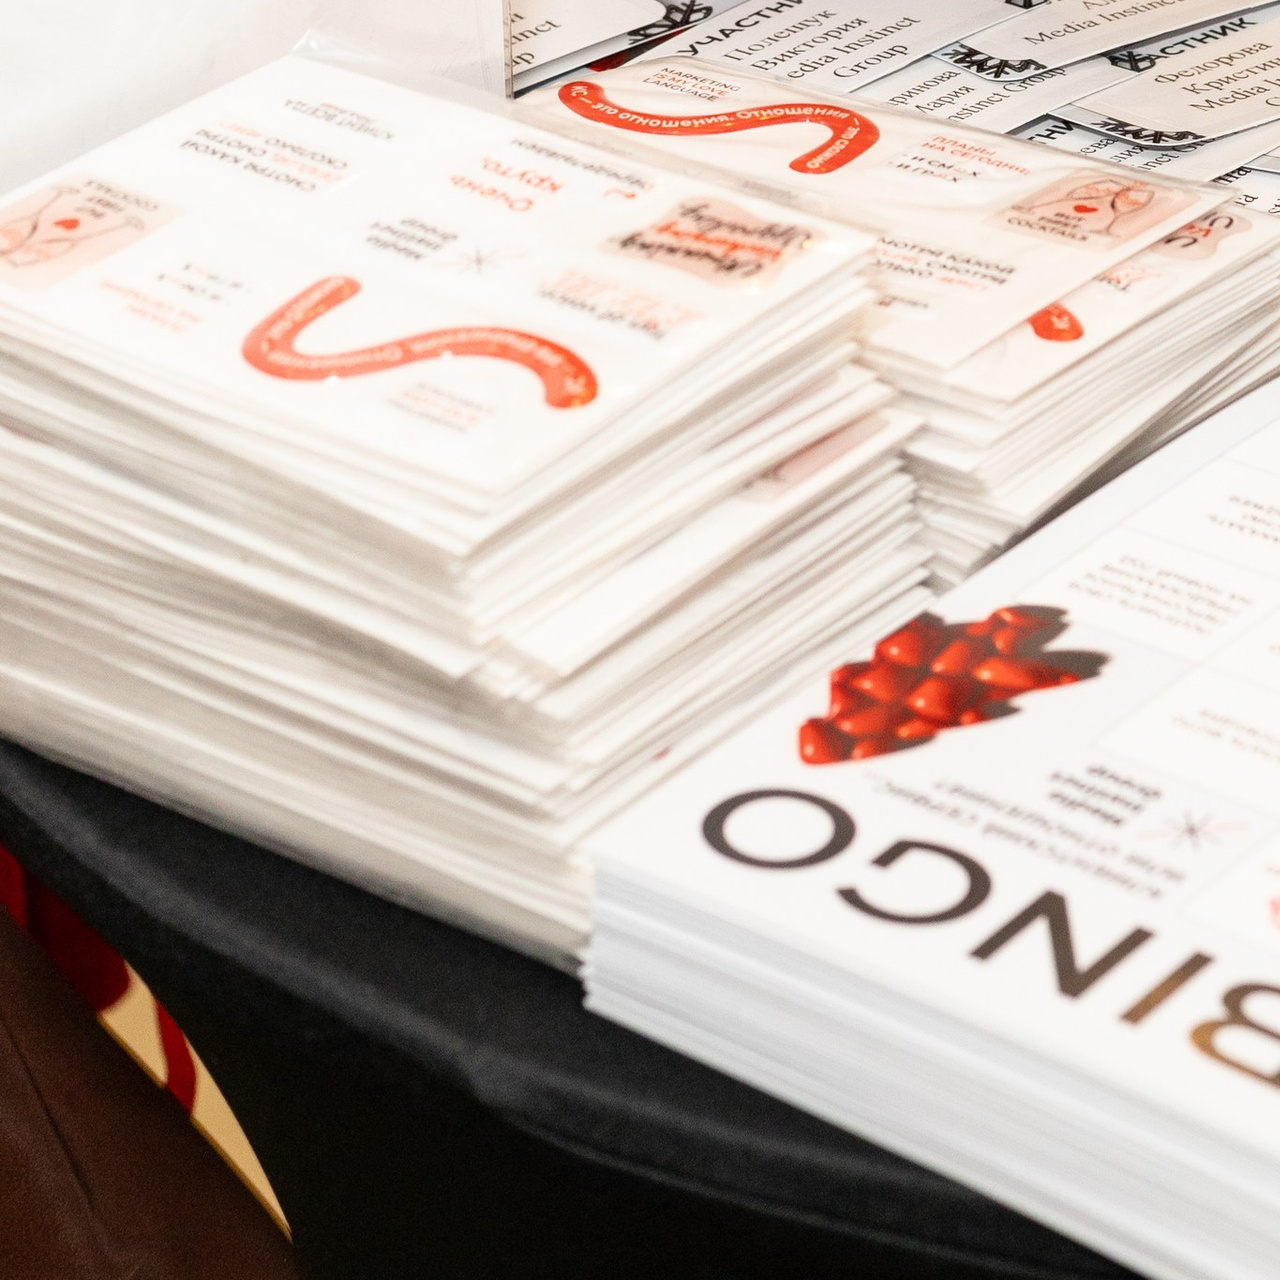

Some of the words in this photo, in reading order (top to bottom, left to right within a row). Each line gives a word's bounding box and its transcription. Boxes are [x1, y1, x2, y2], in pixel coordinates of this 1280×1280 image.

[723, 8, 838, 62] Полещук
[750, 17, 870, 72] Виктория
[787, 53, 839, 79] edia
[832, 15, 923, 56] Instinct
[1024, 19, 1101, 46] Media
[1143, 16, 1259, 63] АСТНИК
[832, 42, 910, 79] Group
[1153, 40, 1273, 86] Федорова
[640, 77, 721, 103] LANGUAGE
[659, 66, 743, 93] MARKETING
[691, 81, 729, 98] LOVE
[947, 90, 1011, 122] nstinct
[1002, 67, 1068, 93] Group
[1188, 82, 1272, 113] Media
[921, 141, 947, 153] НА
[932, 135, 998, 157] ПЛАНЫ
